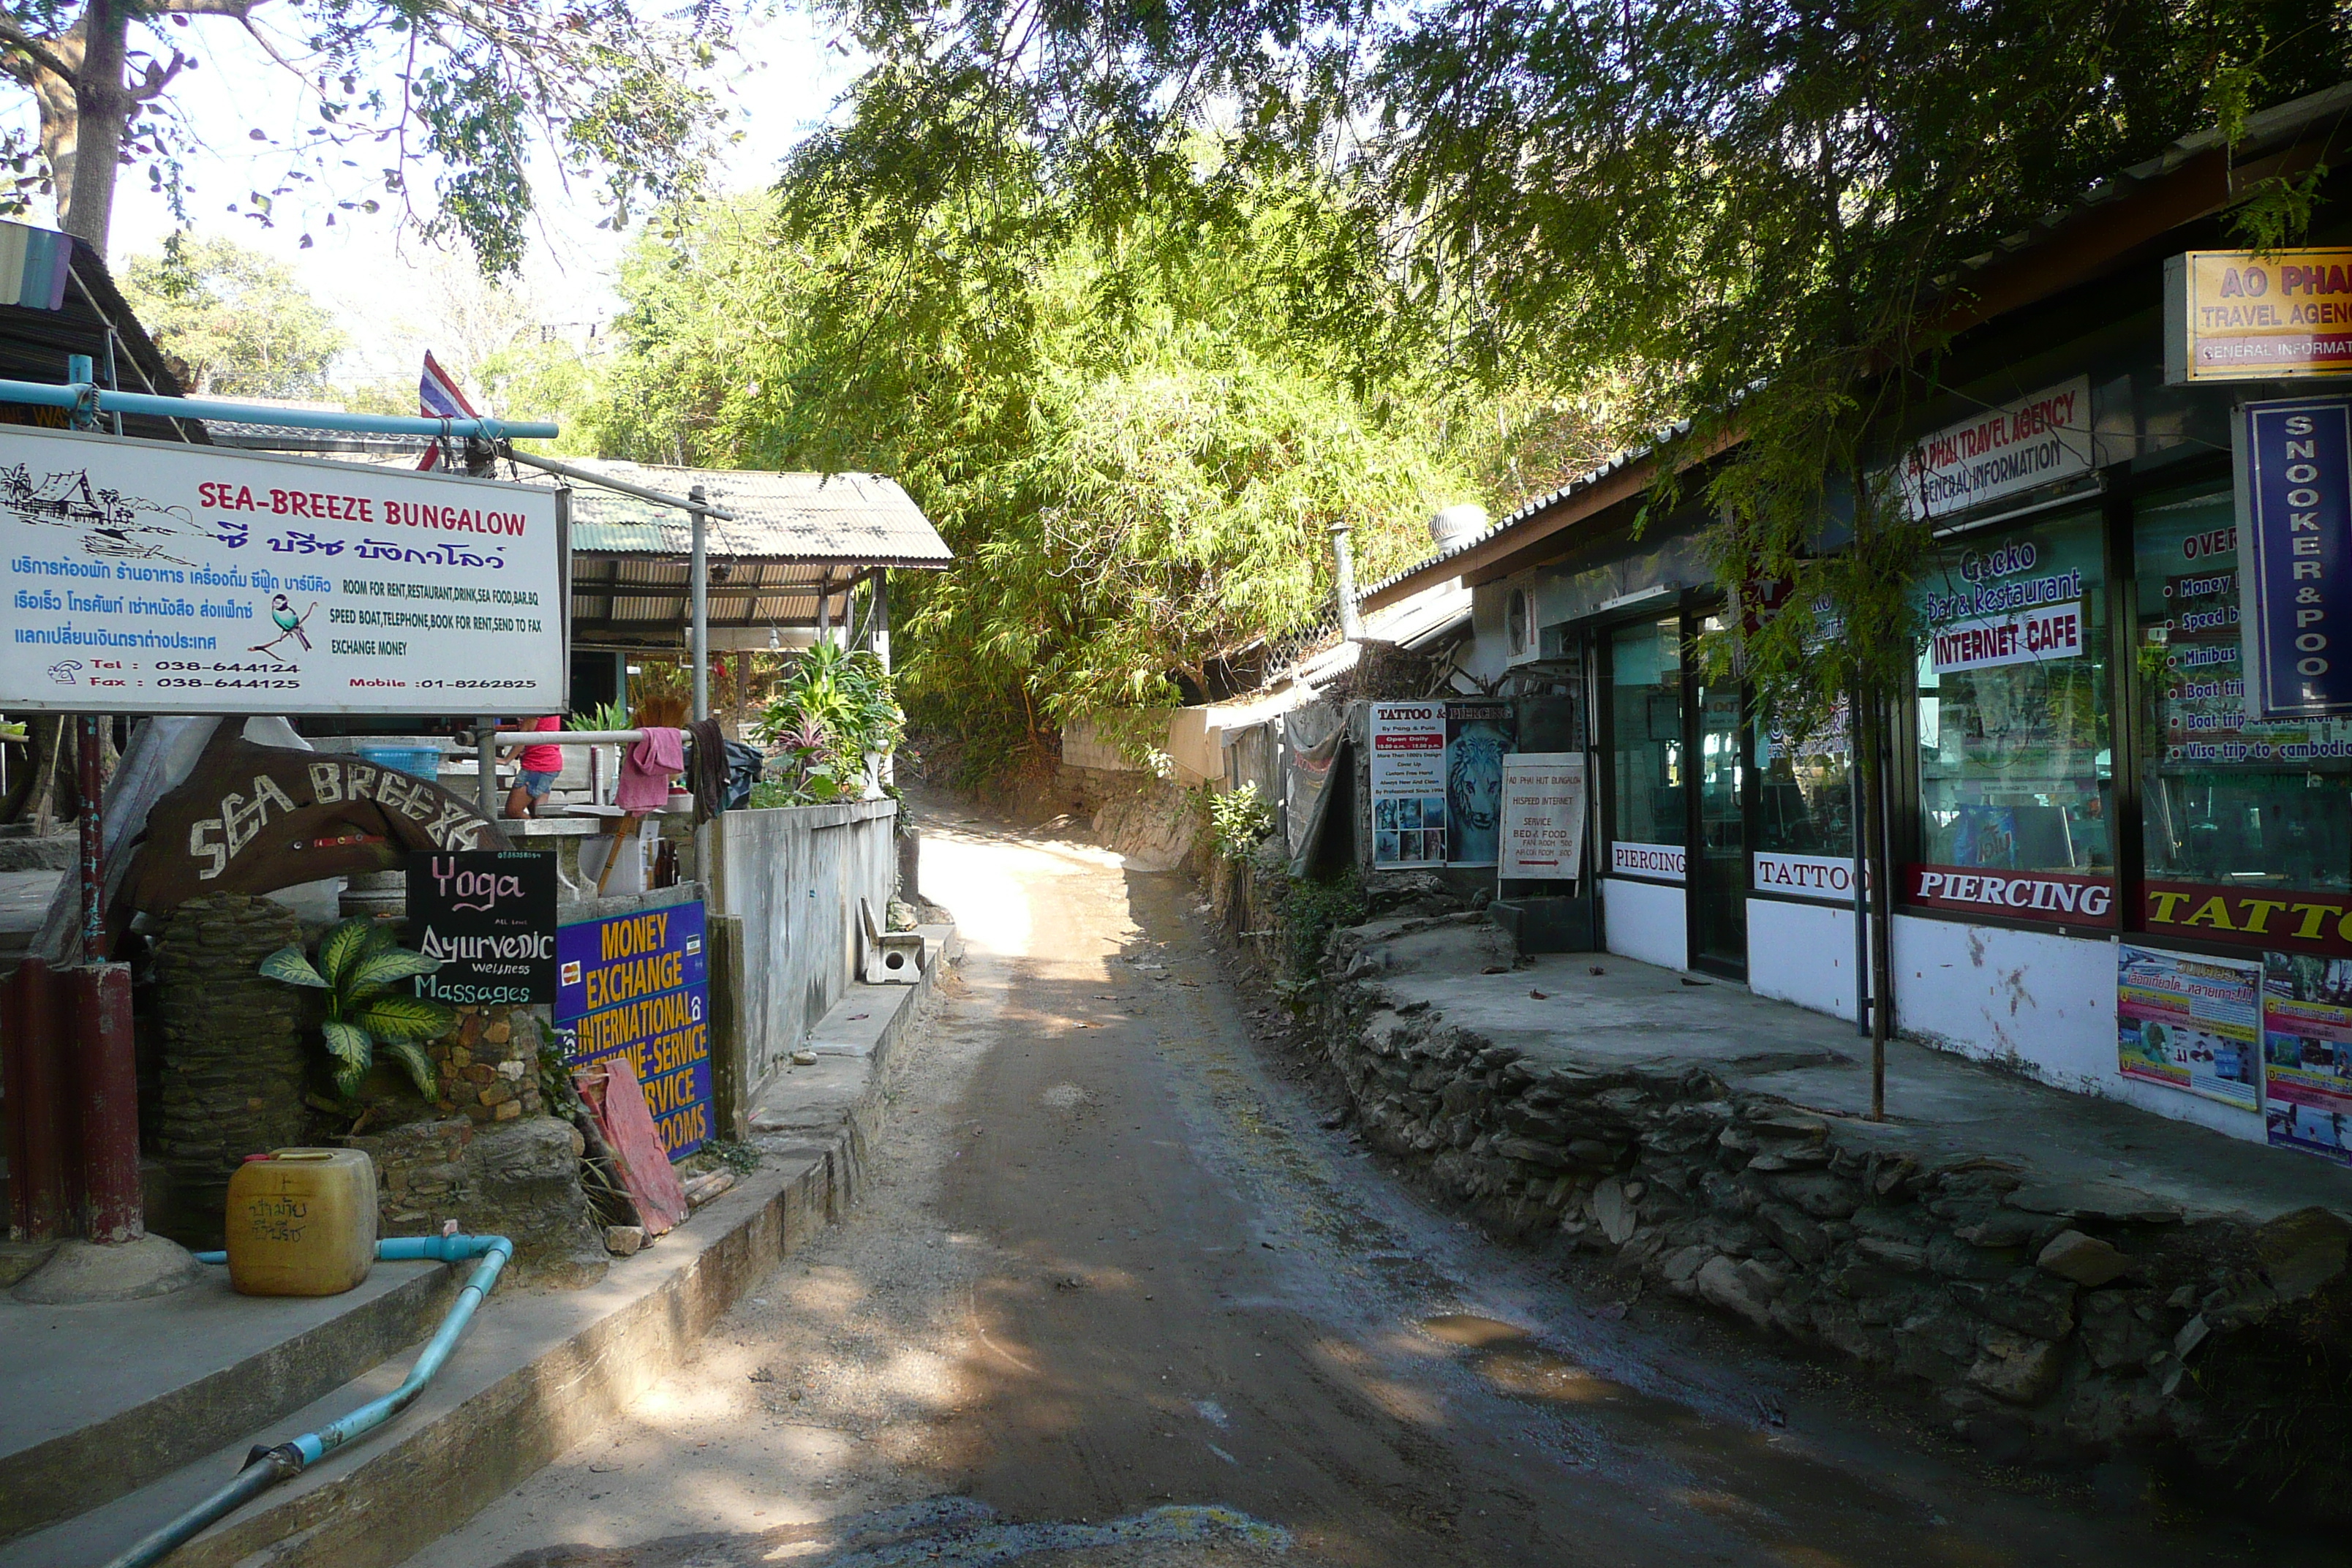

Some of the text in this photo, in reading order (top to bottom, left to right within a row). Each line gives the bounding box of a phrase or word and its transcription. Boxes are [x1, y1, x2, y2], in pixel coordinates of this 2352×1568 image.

[2220, 266, 2267, 298] AO
[2201, 305, 2283, 328] TRAVEL
[2203, 344, 2272, 359] GENERAL
[1929, 437, 1959, 471] PHAI
[1958, 415, 2010, 462] TRAVEL
[2012, 390, 2076, 442] AGENCY
[1921, 439, 2062, 504] GENERAL INFORMATION
[198, 481, 527, 537] SEA-BREEZE BUNGALOW
[217, 520, 249, 549] ซี
[353, 538, 508, 570] บังกาโลว์
[12, 555, 111, 579] บริการห้องพัก
[117, 561, 184, 584] ร้านอาหาร
[189, 562, 248, 589] เครื่องดื่ม
[1960, 538, 2037, 583] Gecko
[343, 579, 368, 595] ROOM
[369, 581, 385, 597] FOR
[1928, 567, 2081, 622] Bar & Restaurant
[2180, 575, 2231, 598] Money
[13, 589, 61, 610] เรือเร็ว
[67, 591, 123, 613] โทรศัพท์
[330, 608, 356, 625] SPEED
[456, 615, 471, 630] FOR
[516, 619, 526, 633] TO
[528, 619, 542, 633] FAX
[2182, 611, 2223, 633] Speed
[331, 639, 407, 656] EXCHANGE MONEY
[1933, 614, 2077, 666] INTERNET CAFE
[90, 659, 122, 669] Tel
[155, 661, 301, 673] 038-644124
[2185, 647, 2236, 668] Minibus
[89, 676, 127, 687] Fax
[157, 677, 301, 689] 038-644125
[350, 678, 406, 687] Mobile
[2187, 681, 2218, 699] Boat
[1378, 708, 1432, 720] TATTOO
[1436, 708, 1447, 719] &
[2187, 713, 2220, 729] Boat
[2223, 712, 2245, 731] trip
[2189, 742, 2215, 758] Visa
[2223, 743, 2247, 761] trip
[2255, 742, 2271, 758] to
[1537, 776, 1549, 785] HUT
[1542, 796, 1574, 805] INTERNET
[189, 774, 298, 881] SEA
[1513, 829, 1532, 838] BED
[1542, 830, 1567, 839] FOOD
[1523, 818, 1552, 826] SERVICE
[1523, 839, 1536, 847] FAN
[1616, 848, 1686, 873] PIERCING
[431, 856, 526, 912] Yoga
[1917, 871, 2111, 916] PIERCING
[601, 912, 668, 962] MONEY
[415, 974, 531, 1006] Massages
[586, 950, 683, 1010] EXCHANGE
[577, 991, 692, 1058] INTERNATIONAL
